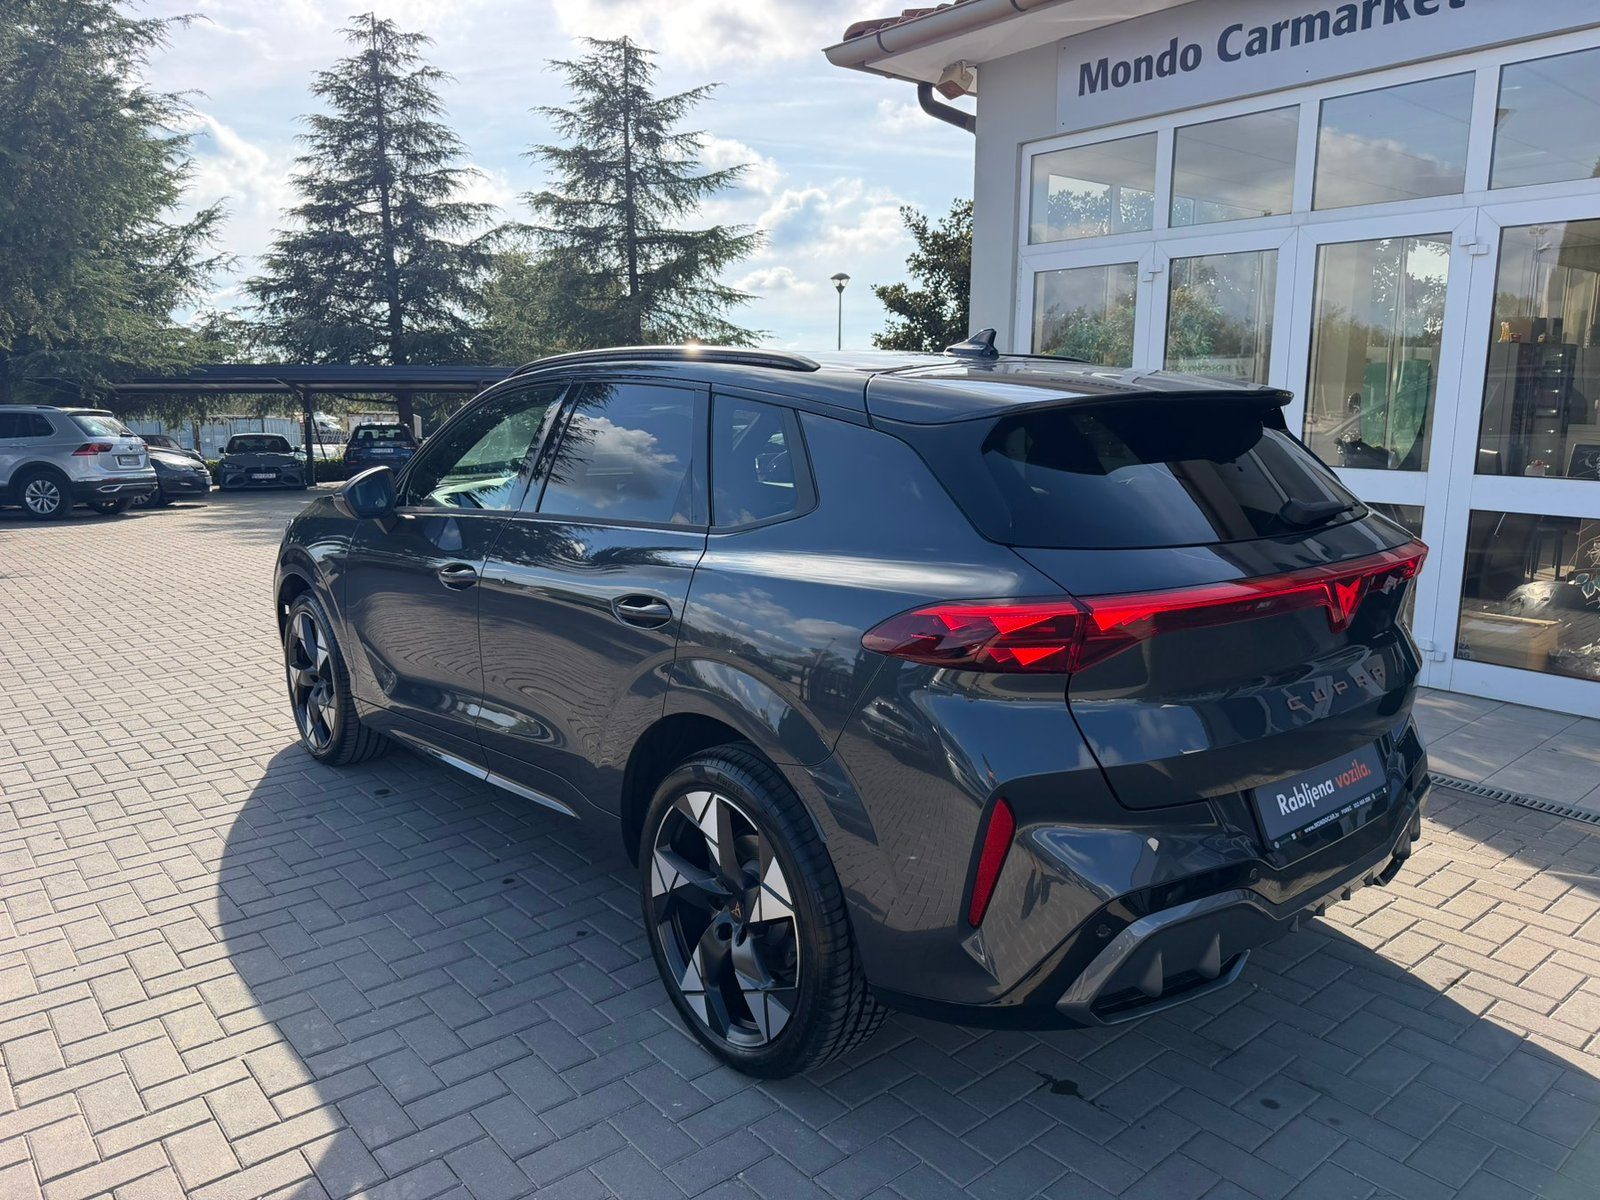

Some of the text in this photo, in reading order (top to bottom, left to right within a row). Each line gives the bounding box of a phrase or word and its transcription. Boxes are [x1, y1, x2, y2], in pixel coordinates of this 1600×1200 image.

[1078, 0, 1466, 96] Mondo Carmarke
[1276, 759, 1372, 816] Rabljena vozila.
